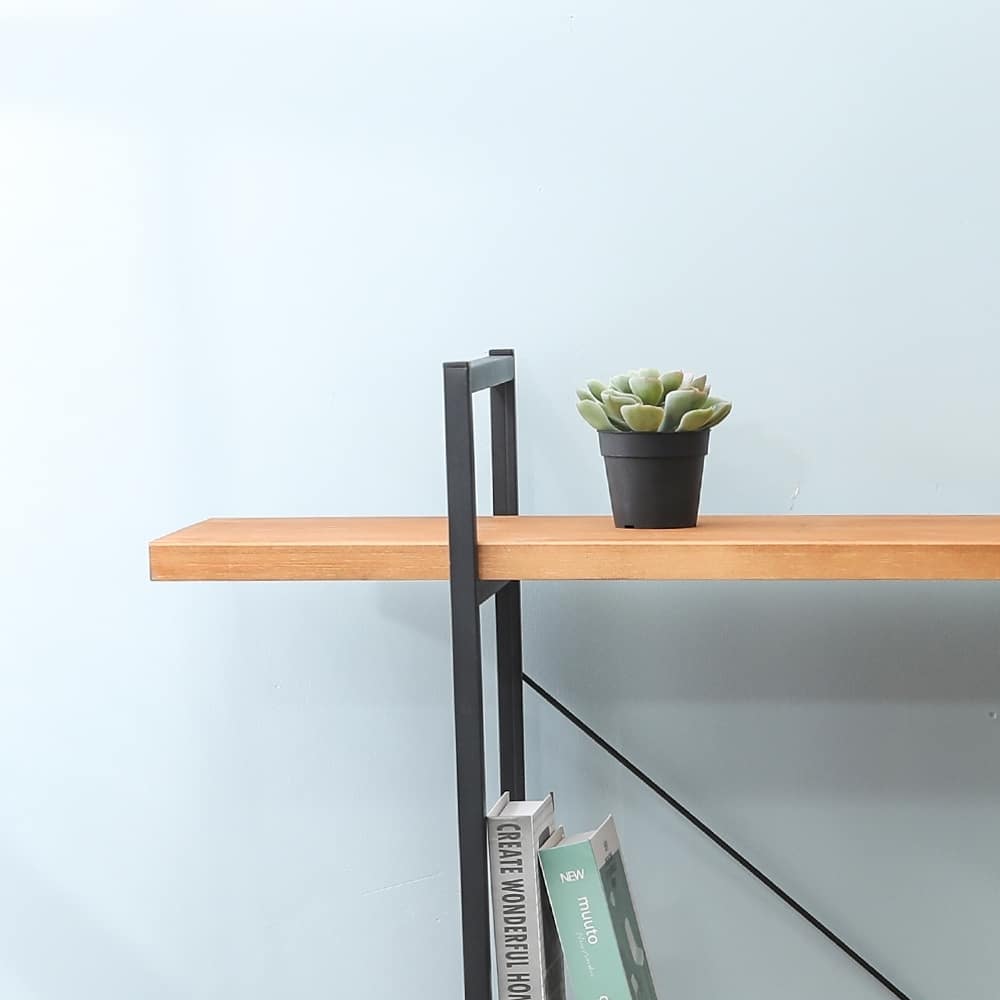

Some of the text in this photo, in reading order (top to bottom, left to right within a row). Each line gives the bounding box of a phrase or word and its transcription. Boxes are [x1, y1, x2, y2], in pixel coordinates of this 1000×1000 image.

[496, 822, 523, 875] CREATE
[560, 868, 585, 883] NEW
[501, 879, 530, 969] WONDERFUL
[577, 896, 599, 945] muuto
